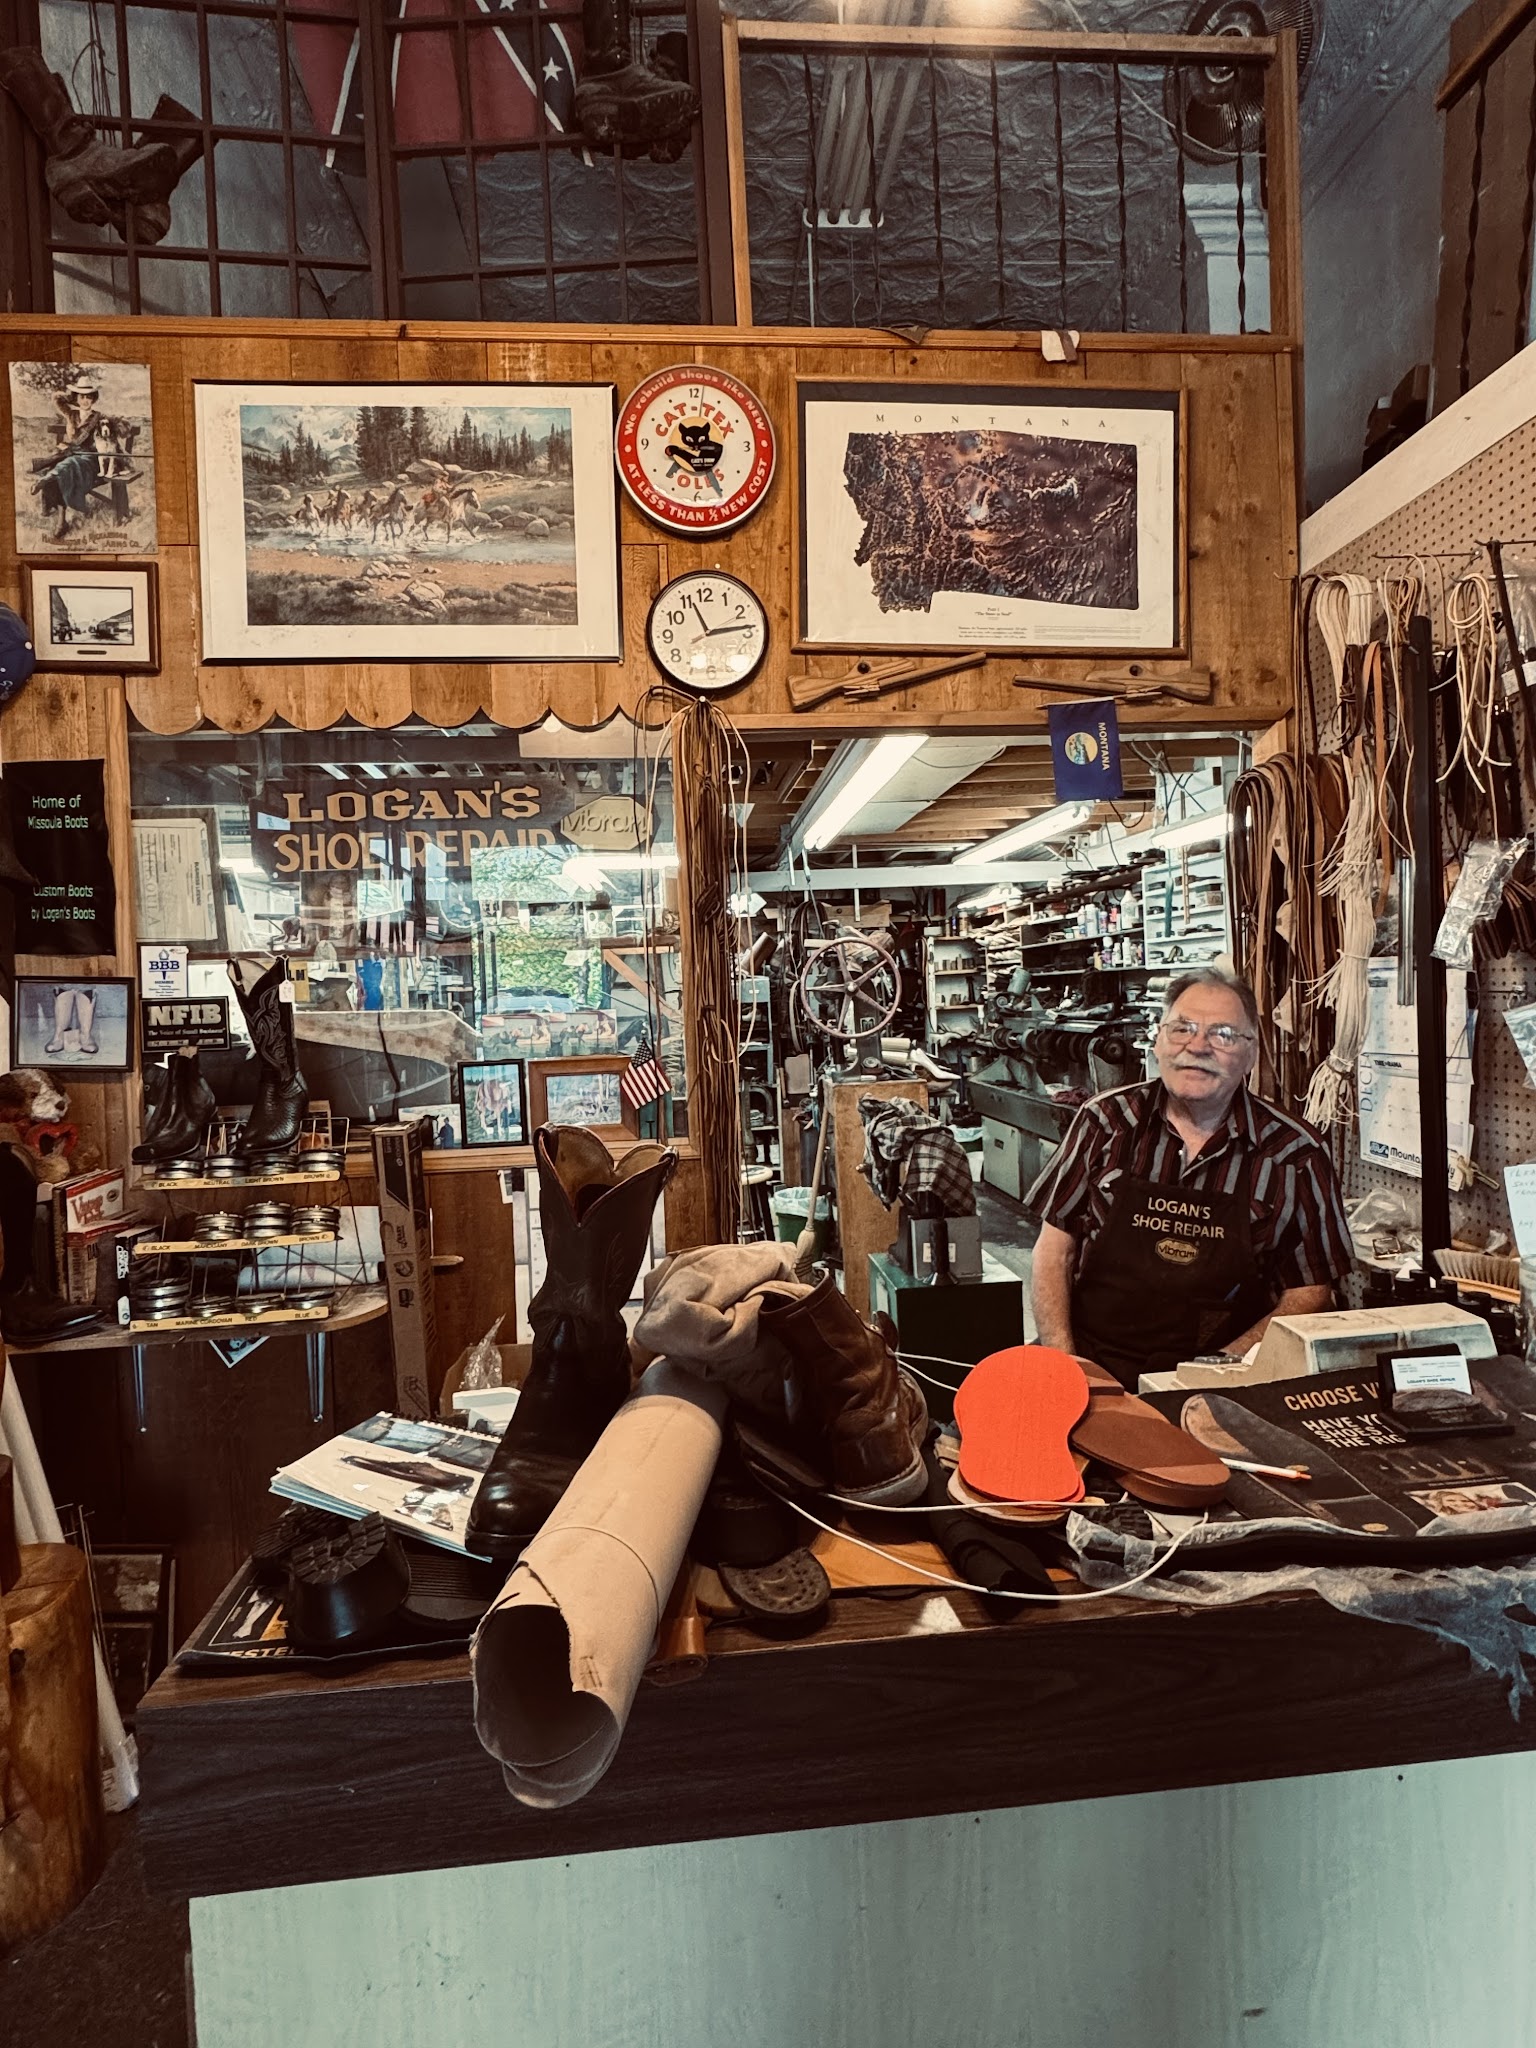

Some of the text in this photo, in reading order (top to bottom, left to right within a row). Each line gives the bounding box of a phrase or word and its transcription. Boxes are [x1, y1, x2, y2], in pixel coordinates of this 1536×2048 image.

[689, 388, 700, 399] 12
[625, 370, 767, 436] We rebuild shoes like NEW
[655, 402, 735, 440] CAT-TEX
[640, 438, 650, 451] 9
[743, 442, 751, 453] 3
[627, 463, 641, 480] AT
[637, 481, 666, 511] LESS
[669, 506, 705, 522] THAN
[720, 494, 748, 516] NEW
[749, 459, 768, 493] COST
[680, 595, 693, 609] 11
[696, 588, 714, 602] 12
[721, 592, 728, 607] 1
[666, 610, 685, 626] 10
[735, 605, 747, 620] 2
[662, 629, 674, 644] 9
[670, 648, 682, 663] 8
[1098, 722, 1111, 771] MONTANA
[32, 794, 81, 809] Home of
[282, 780, 541, 821] LOGAN'S
[27, 815, 89, 829] Missoula Boots
[275, 830, 384, 873] SHOE
[68, 884, 94, 897] Boots
[31, 905, 96, 922] by Logan's Boots
[148, 960, 180, 970] BBB
[147, 1003, 222, 1026] NFIB
[1148, 1197, 1212, 1220] LOGAN'S
[1132, 1213, 1225, 1239] SHOE REPAIR
[1284, 1385, 1363, 1411] CHOOSE
[1301, 1416, 1359, 1431] HAVE
[1314, 1426, 1383, 1440] SHOES
[1324, 1436, 1371, 1448] THE
